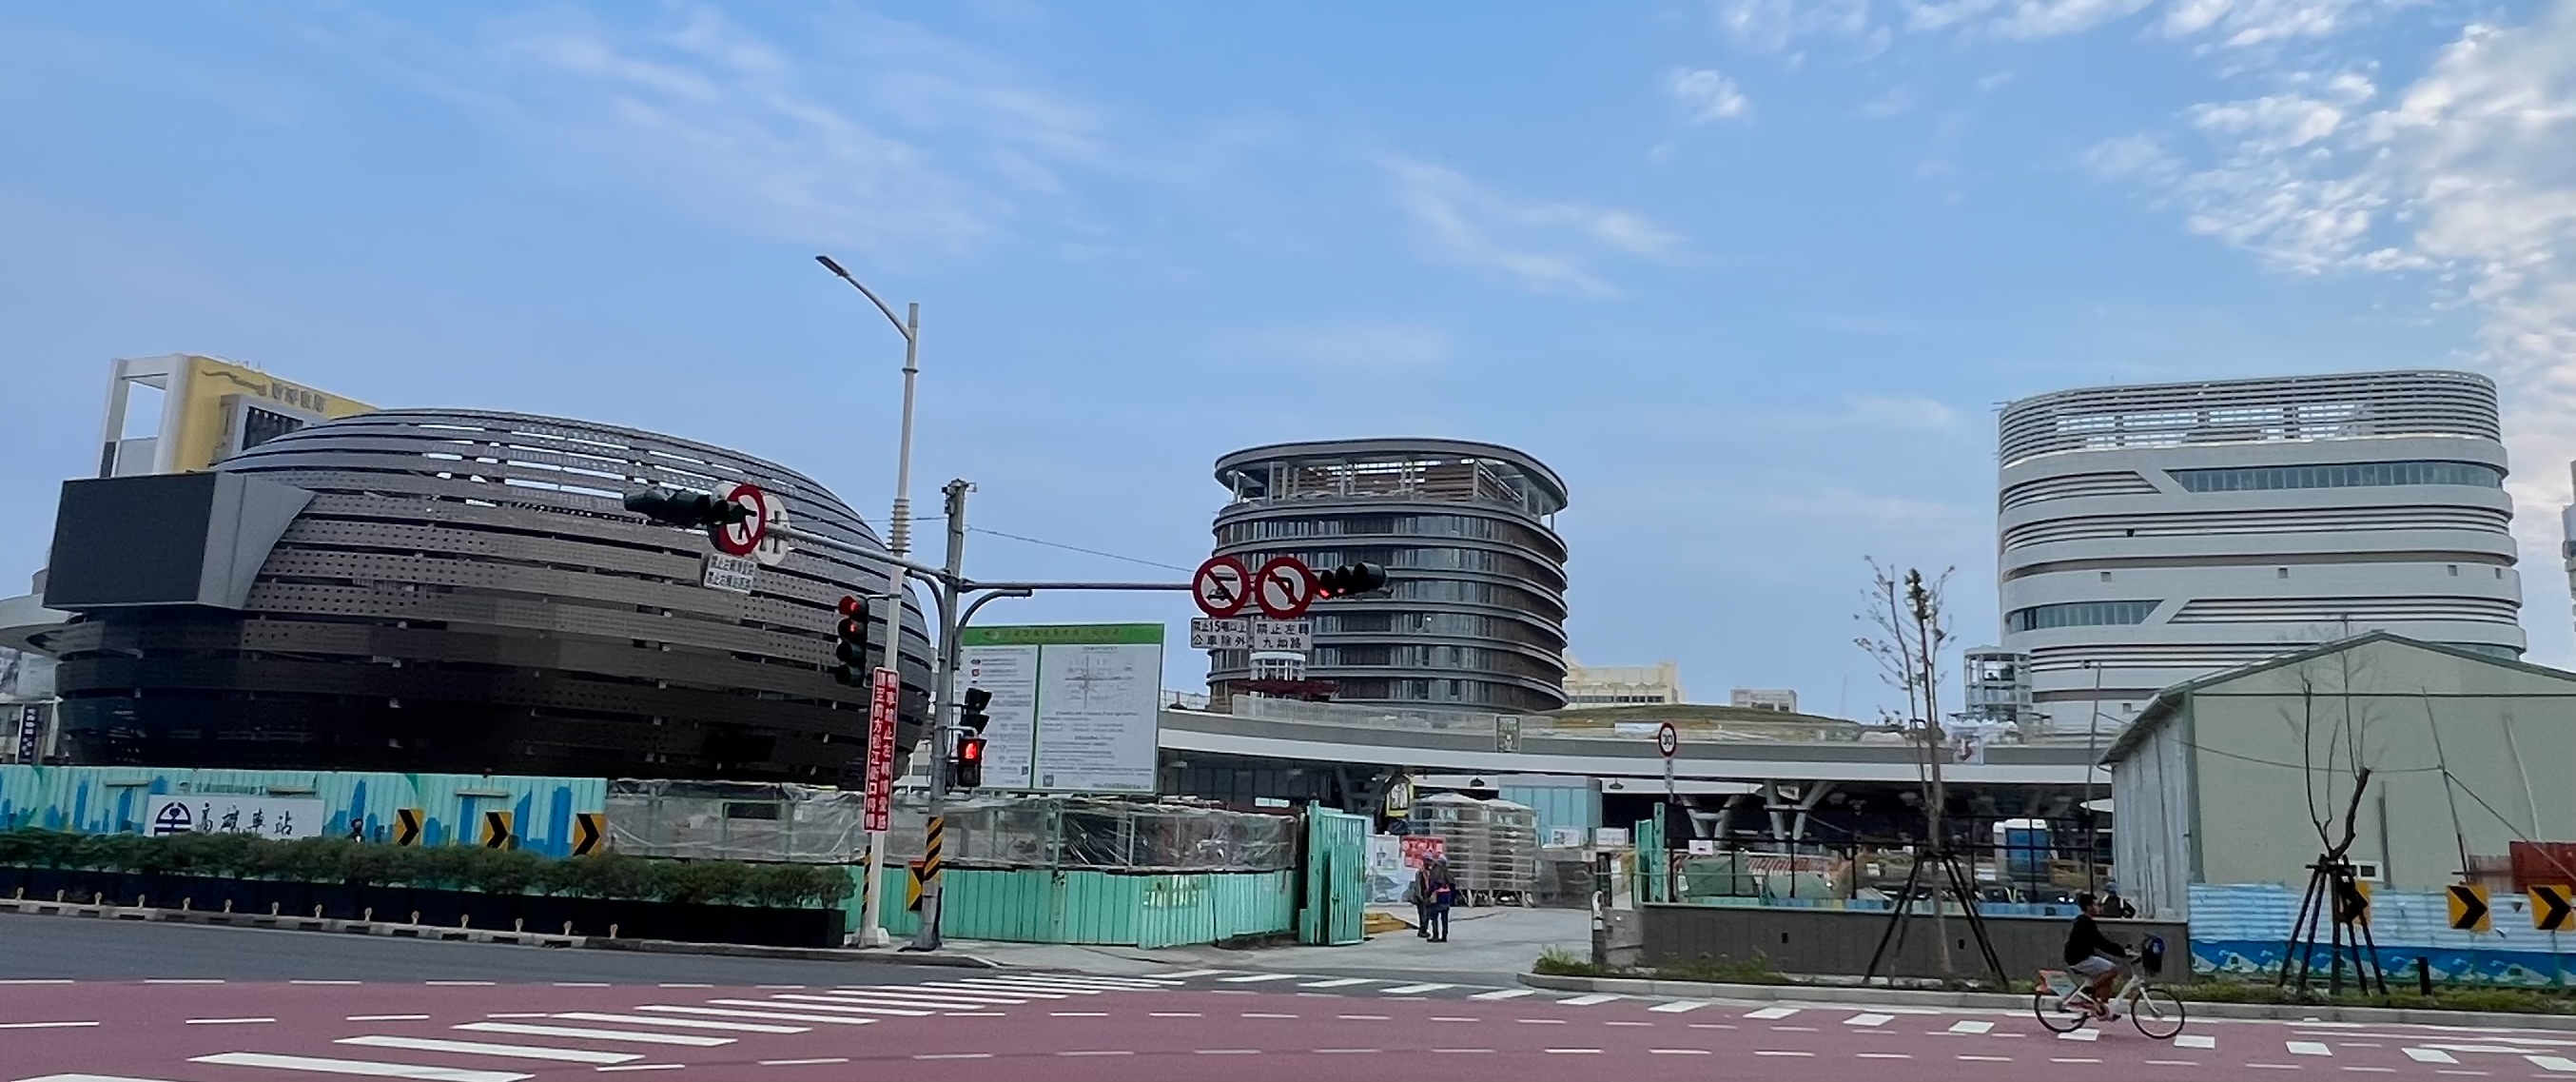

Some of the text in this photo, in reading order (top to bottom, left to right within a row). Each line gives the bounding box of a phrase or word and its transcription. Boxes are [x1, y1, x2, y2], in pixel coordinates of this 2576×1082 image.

[1257, 623, 1310, 635] 禁止左轉
[1194, 634, 1246, 646] 公車除外
[1263, 637, 1301, 648] 九如路
[1663, 733, 1673, 745] 30
